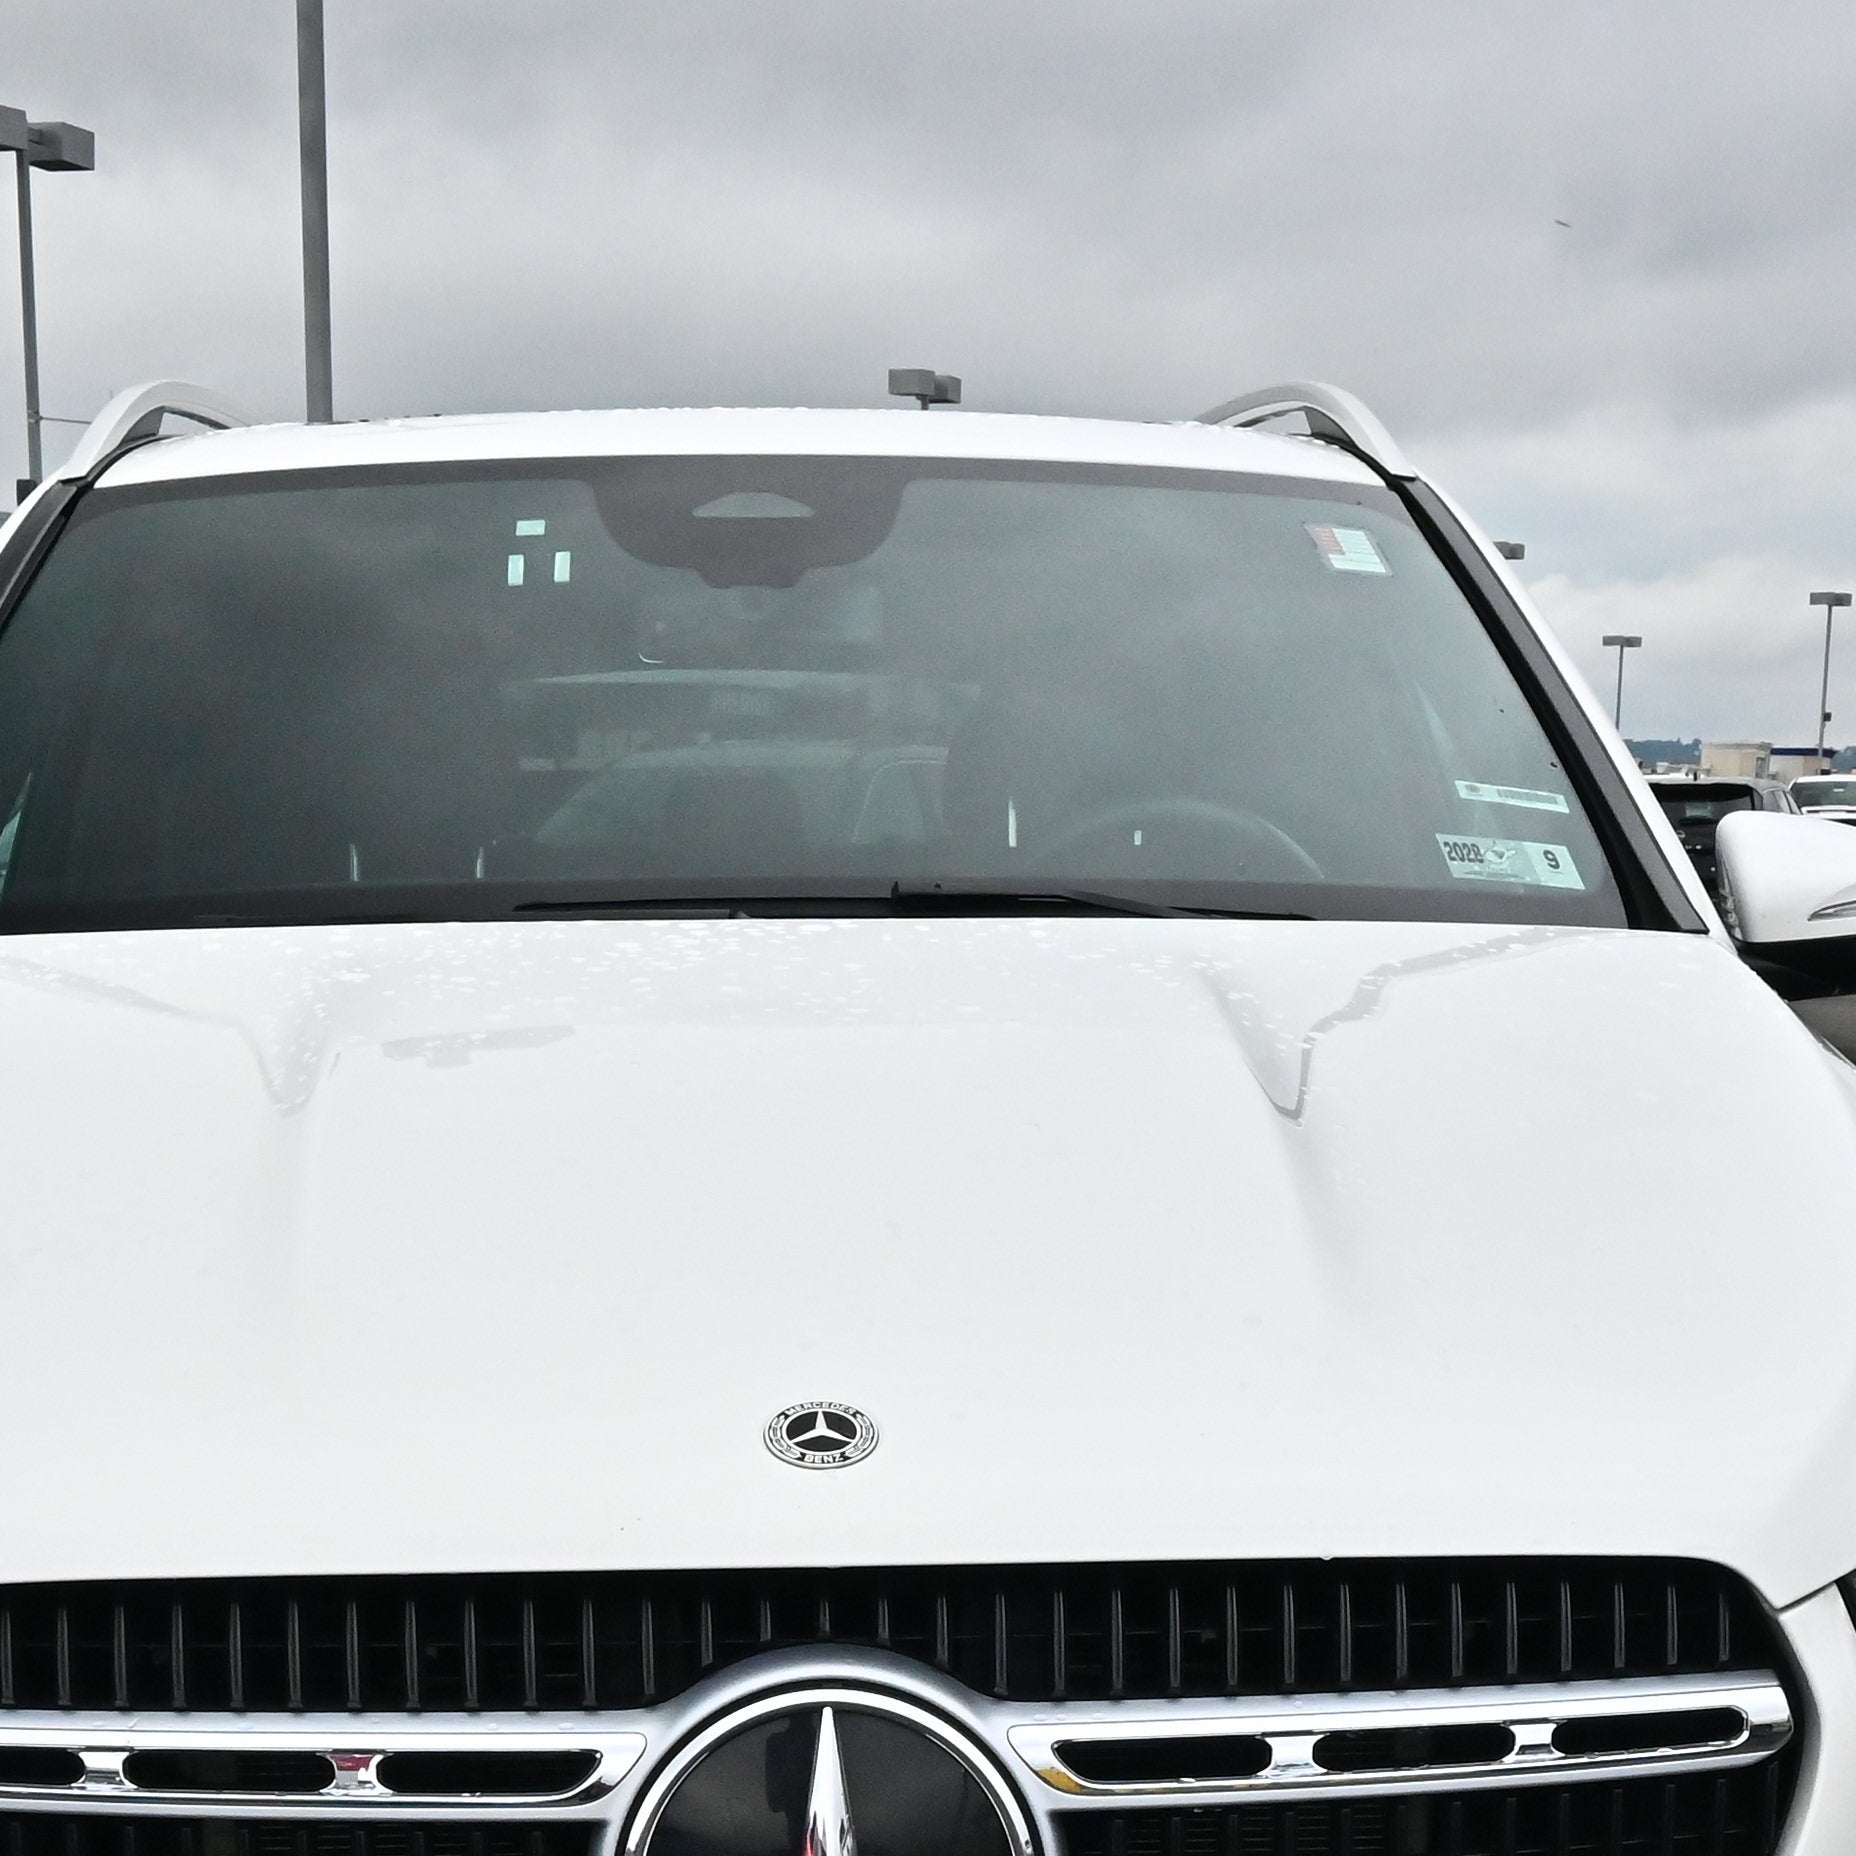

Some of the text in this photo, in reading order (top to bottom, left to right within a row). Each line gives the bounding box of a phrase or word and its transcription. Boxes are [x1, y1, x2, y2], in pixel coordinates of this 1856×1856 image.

[1543, 850, 1561, 870] 9
[784, 1401, 857, 1416] MERCEDES
[804, 1453, 844, 1464] BENZ
